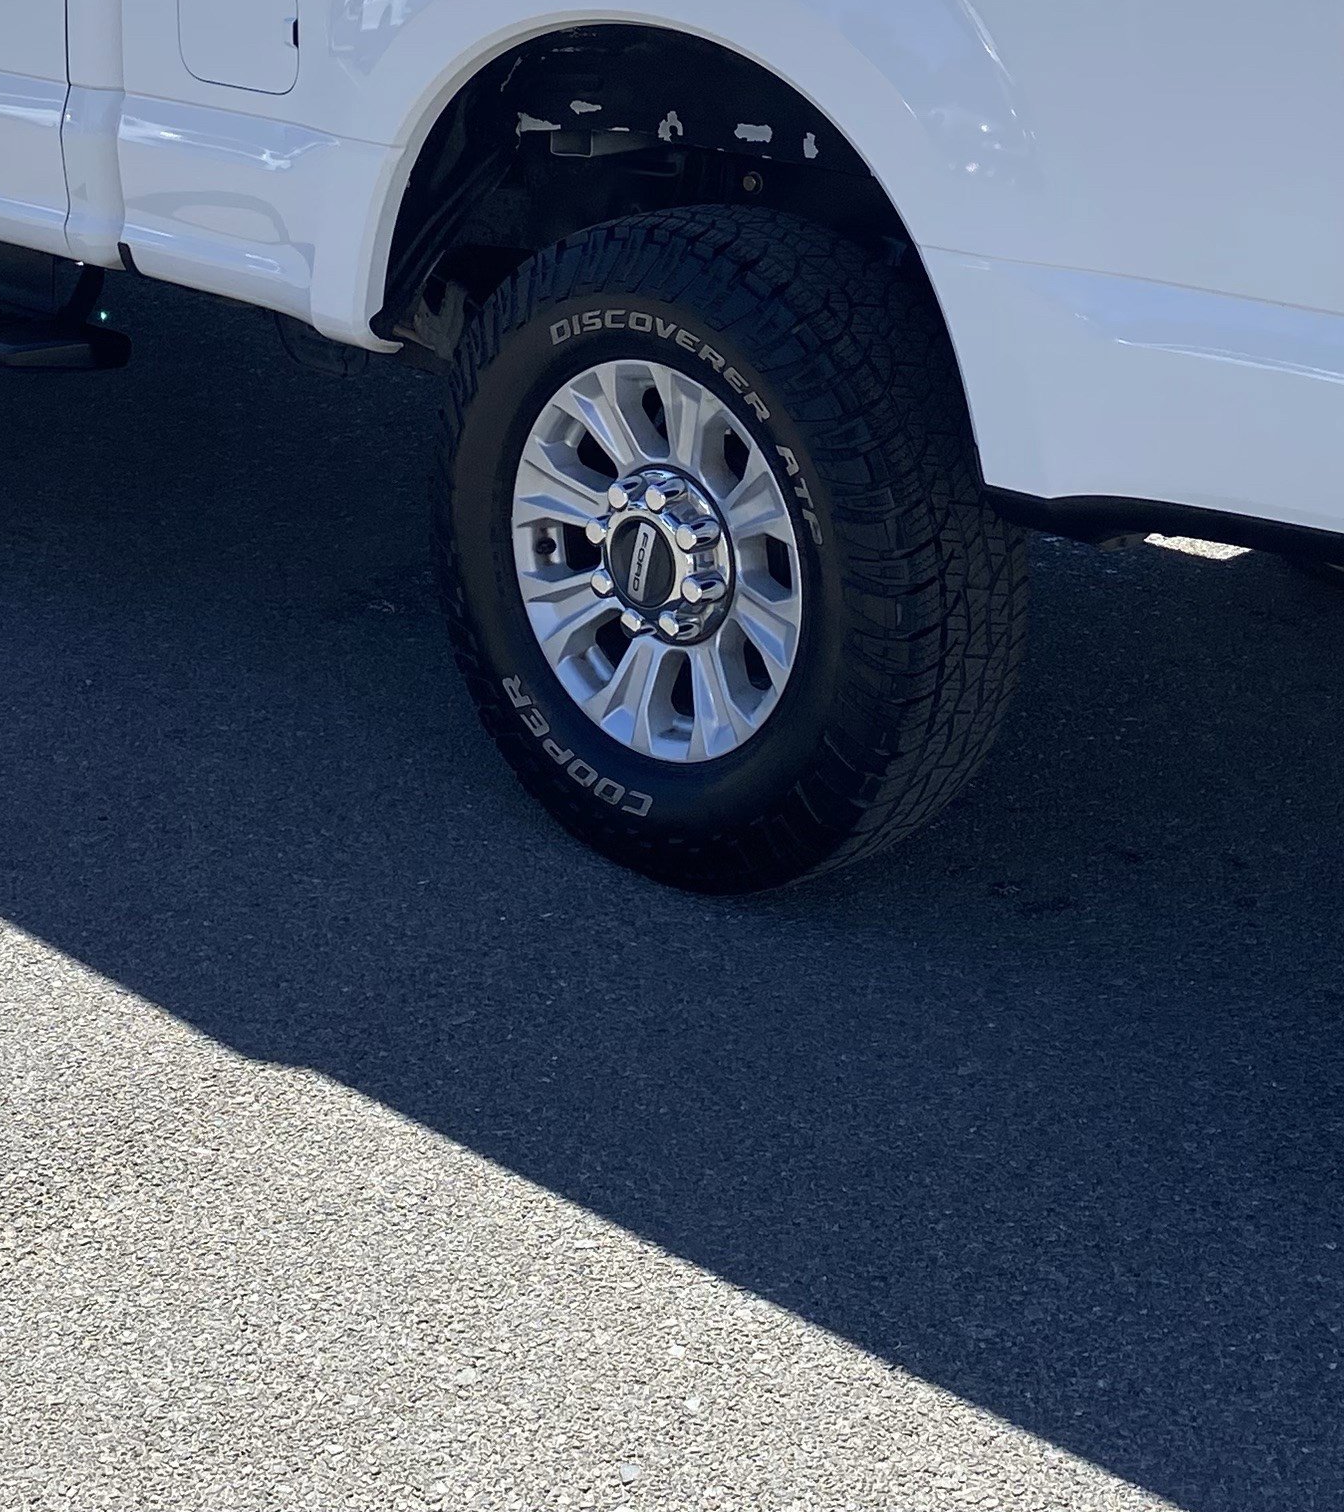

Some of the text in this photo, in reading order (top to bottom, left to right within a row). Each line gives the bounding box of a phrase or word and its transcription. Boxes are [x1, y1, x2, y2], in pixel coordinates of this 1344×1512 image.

[550, 308, 823, 545] DISCOVERER ATP
[633, 532, 649, 592] FORD
[502, 675, 653, 817] COOPER
